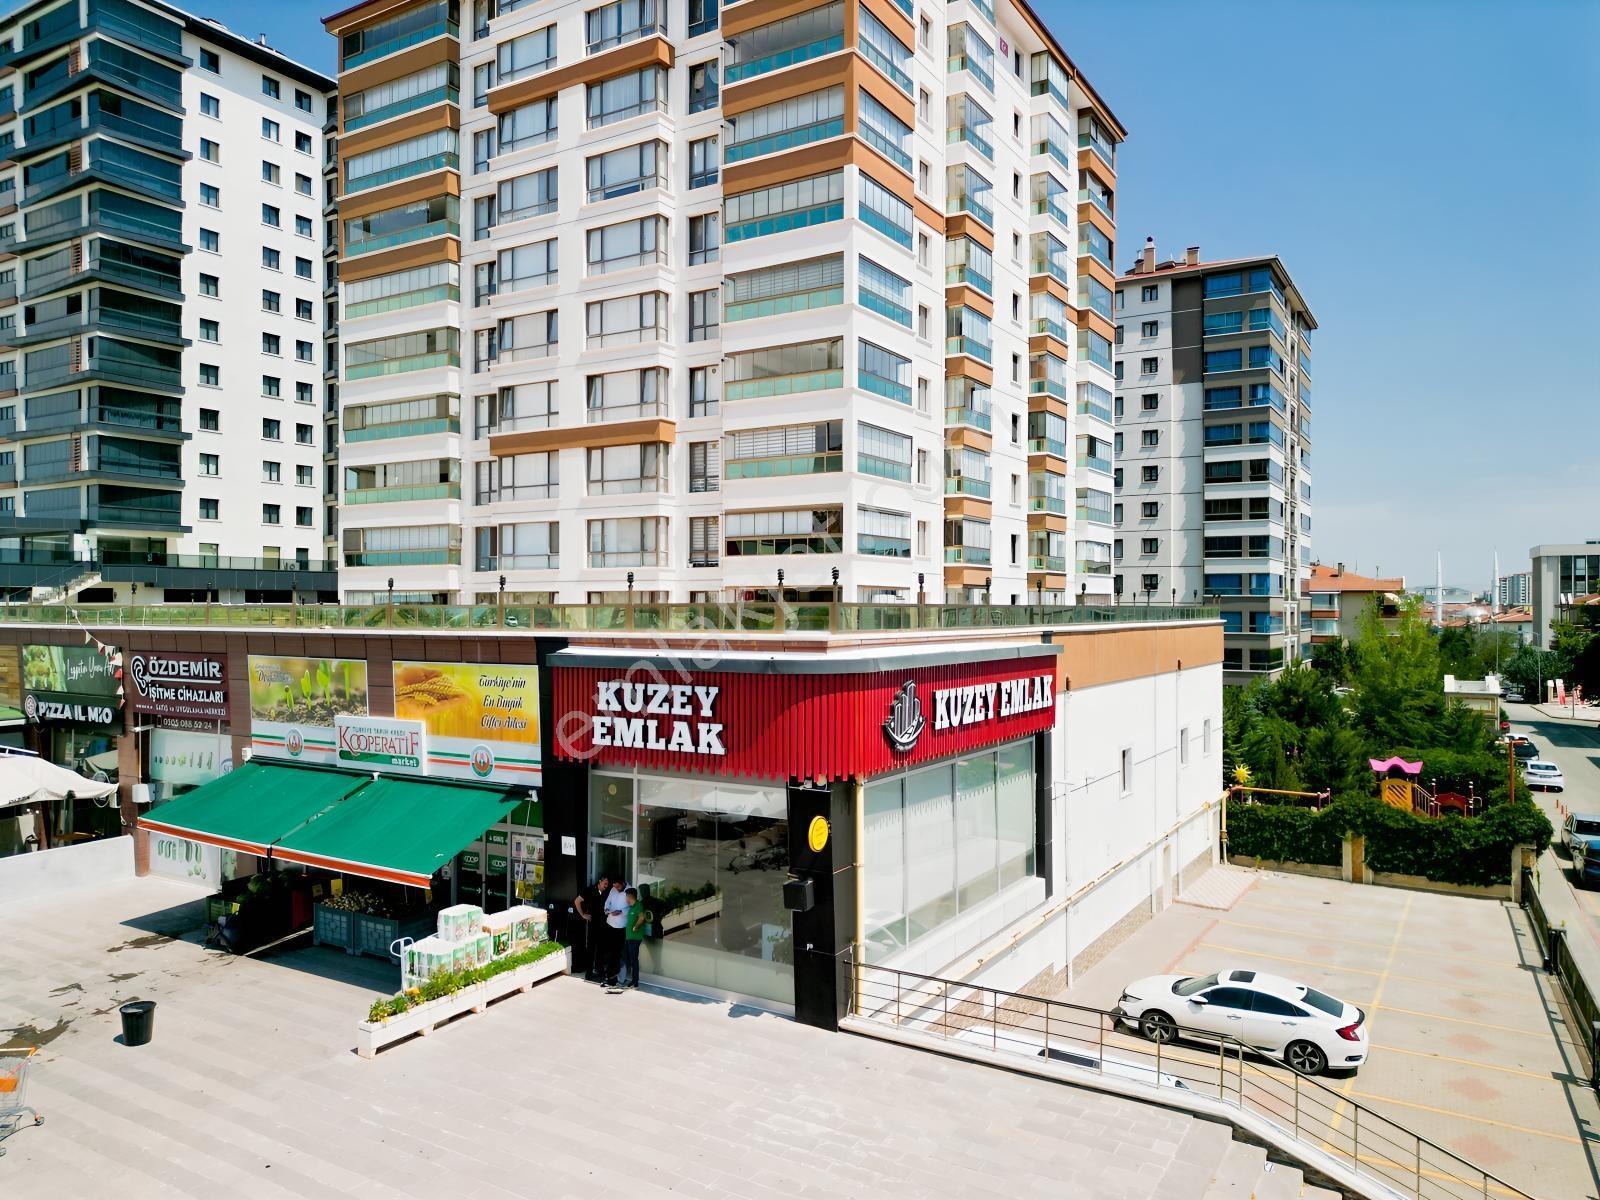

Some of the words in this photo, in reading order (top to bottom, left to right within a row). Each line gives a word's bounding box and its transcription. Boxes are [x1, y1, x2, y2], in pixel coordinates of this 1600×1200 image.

[149, 656, 222, 677] ÖZDEMİR
[149, 684, 176, 702] İŞİTME
[177, 686, 224, 703] CİHAZLARI
[597, 681, 719, 717] KUZEY
[934, 683, 998, 730] KUZEY
[1000, 675, 1053, 717] EMLAK
[592, 715, 727, 755] EMLAK
[391, 758, 417, 767] market
